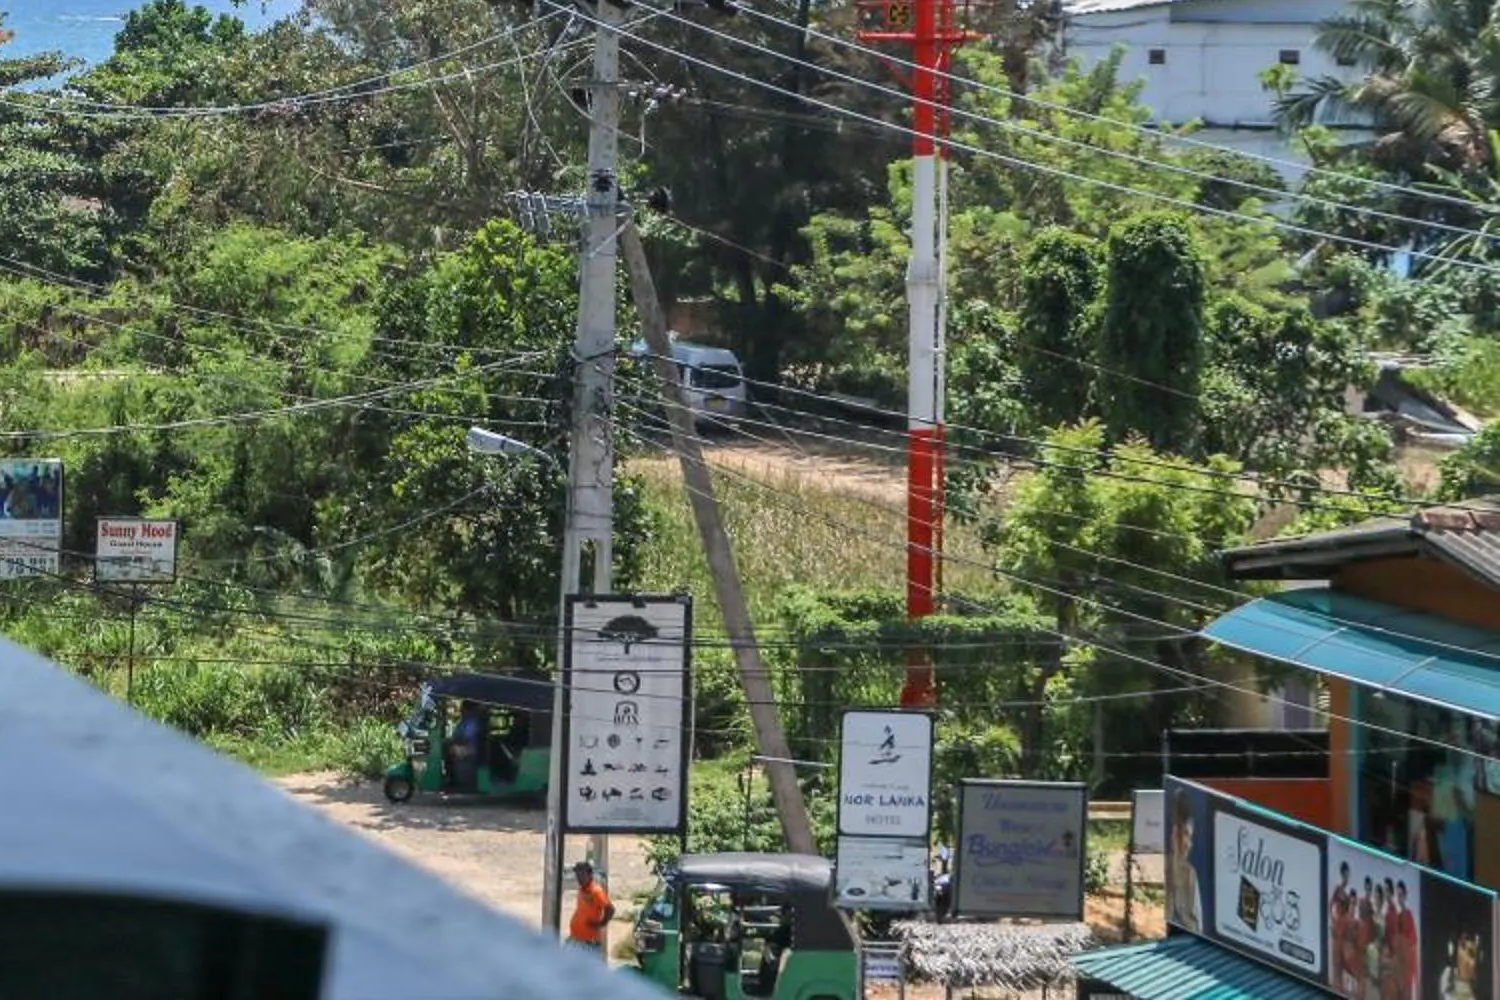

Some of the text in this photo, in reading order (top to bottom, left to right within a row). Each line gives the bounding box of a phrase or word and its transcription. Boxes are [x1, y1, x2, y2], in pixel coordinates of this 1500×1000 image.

[100, 522, 136, 540] Sunny
[844, 794, 925, 807] NOR LANKA
[1228, 826, 1285, 886] Salon
